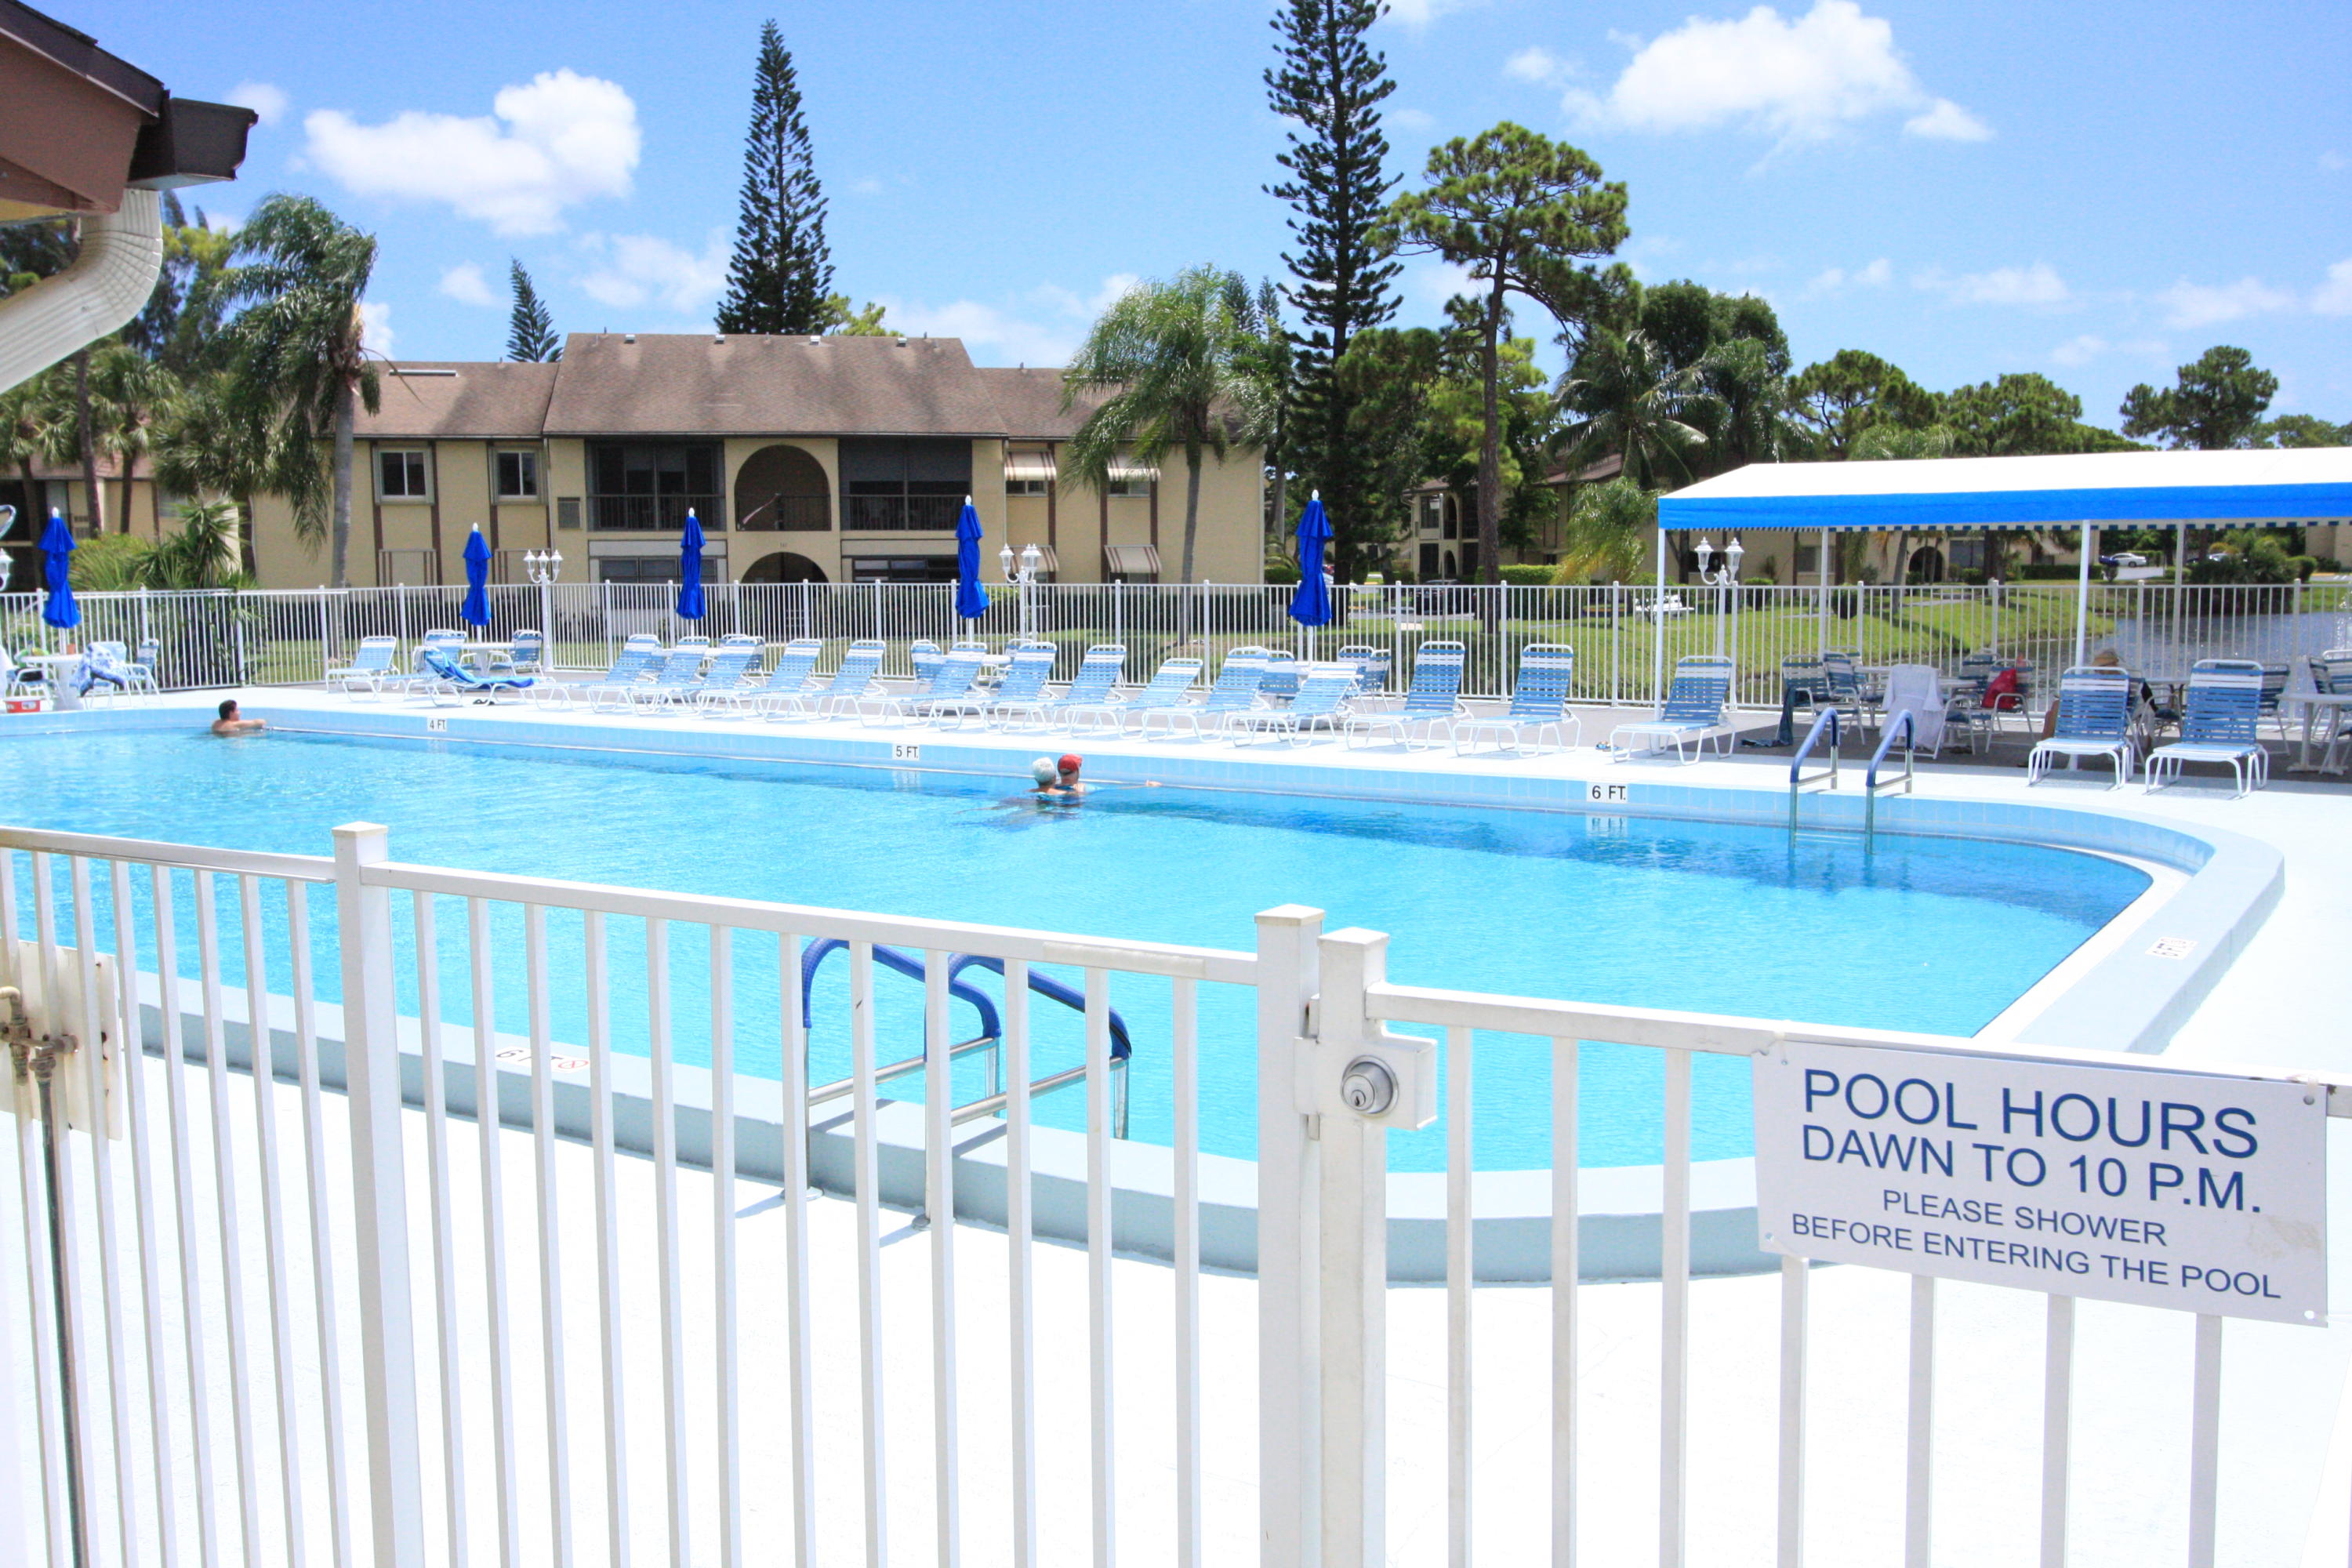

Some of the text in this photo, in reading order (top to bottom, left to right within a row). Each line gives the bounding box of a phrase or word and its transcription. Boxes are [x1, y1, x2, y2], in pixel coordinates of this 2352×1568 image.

[430, 719, 434, 730] 4
[896, 746, 919, 759] 5 FT.
[1592, 785, 1627, 800] 6 FT.
[1804, 1068, 2259, 1159] POOL HOURS
[1802, 1124, 2262, 1214] DAWN TO 10 P.M.
[1883, 1189, 2167, 1246] PLEASE SHOWER
[1792, 1213, 2281, 1299] BEFORE ENTERING THE POOL
